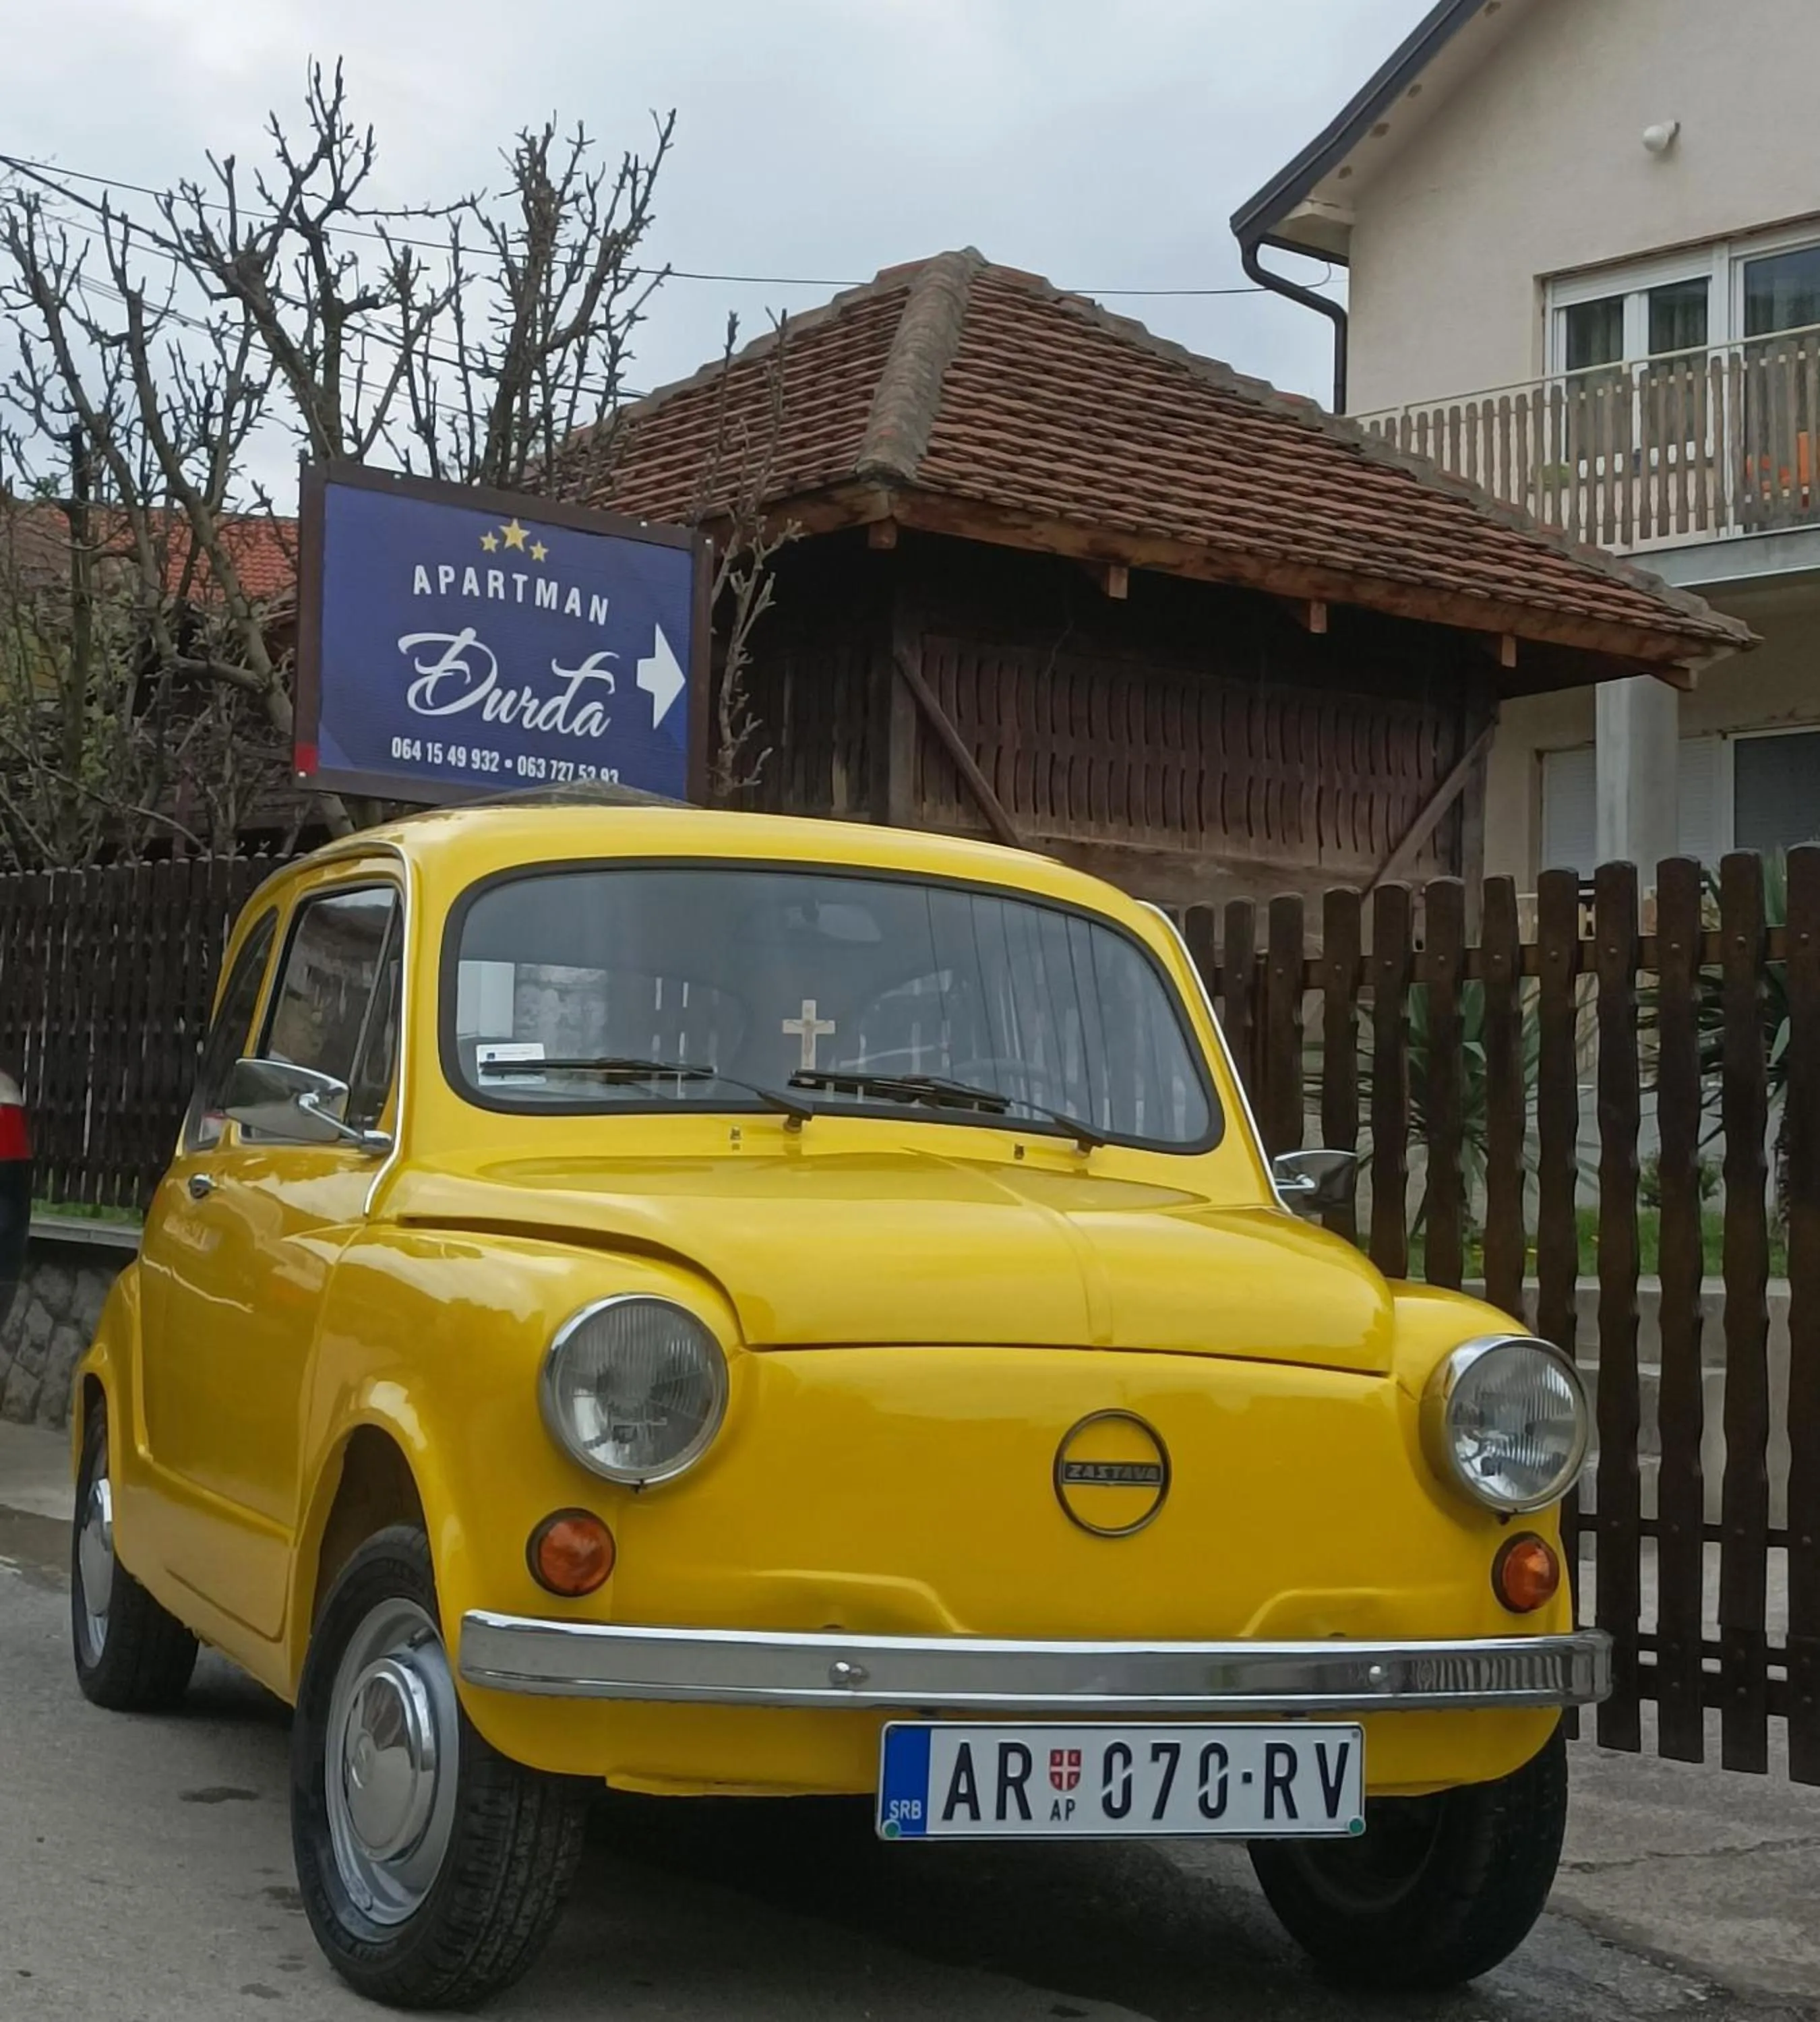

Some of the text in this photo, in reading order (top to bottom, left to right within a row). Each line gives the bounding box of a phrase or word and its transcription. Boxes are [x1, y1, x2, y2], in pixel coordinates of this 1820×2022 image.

[413, 565, 609, 625] APARTMAN
[392, 737, 422, 762] 064
[426, 742, 443, 765] 15
[447, 745, 467, 768] 49
[471, 748, 500, 772] 932
[517, 755, 546, 779] 063
[549, 760, 574, 782] 727
[1067, 1464, 1159, 1480] ZASTAVA
[942, 1740, 1033, 1821] AR
[889, 1799, 923, 1820] SRB
[1050, 1797, 1076, 1821] AP
